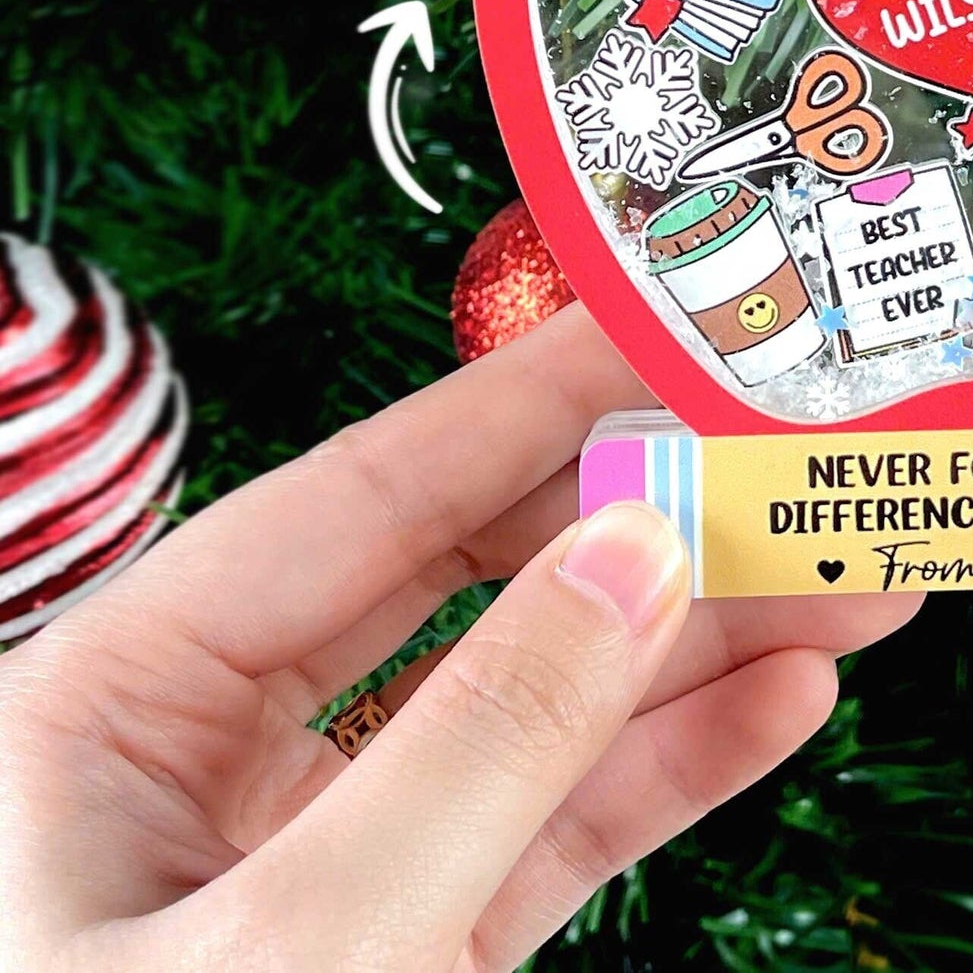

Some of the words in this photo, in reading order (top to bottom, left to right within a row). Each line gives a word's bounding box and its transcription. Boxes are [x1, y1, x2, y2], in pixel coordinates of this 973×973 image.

[860, 206, 921, 245] BEST
[848, 241, 958, 289] TEACHER
[881, 285, 945, 322] EVER
[807, 453, 931, 488] NEVER
